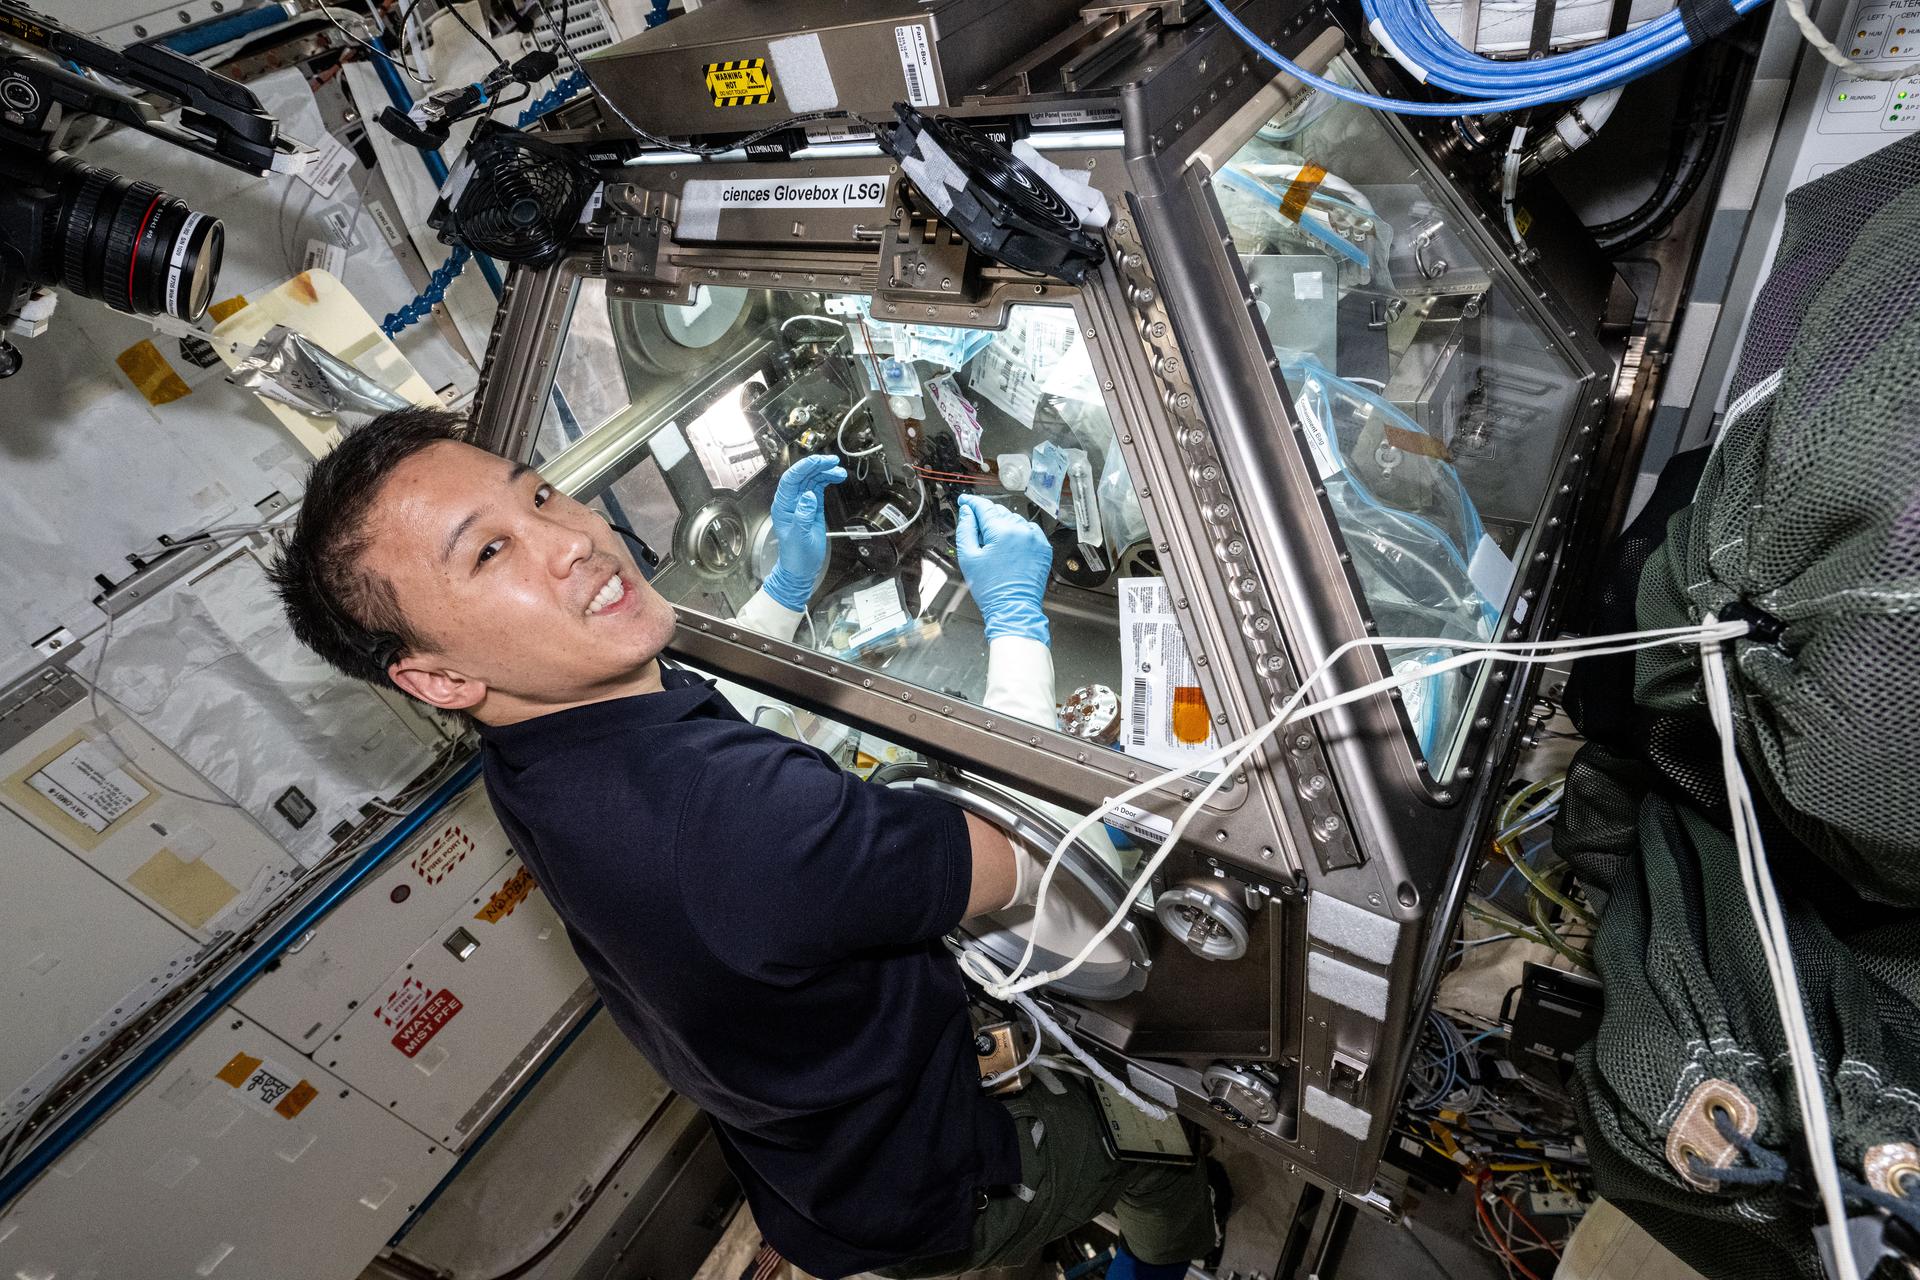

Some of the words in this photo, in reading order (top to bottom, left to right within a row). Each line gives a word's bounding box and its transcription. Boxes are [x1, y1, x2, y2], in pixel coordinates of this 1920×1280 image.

[1867, 13, 1886, 21] LEFT
[915, 26, 923, 41] Fan
[918, 42, 928, 66] E-Box
[714, 71, 743, 81] WARNING
[724, 81, 738, 90] HOT
[747, 144, 784, 155] ILLUMINATION
[589, 153, 618, 162] ILLUMINATION
[722, 186, 770, 202] ciences
[774, 185, 839, 201] Glovebox
[842, 183, 886, 204] (LSG)
[1315, 430, 1325, 446] Bag
[1120, 807, 1137, 818] Door
[427, 858, 442, 873] FIRE
[442, 840, 461, 858] PORT
[393, 994, 414, 1013] FIRE
[433, 998, 460, 1024] PFE
[401, 996, 447, 1039] WATER
